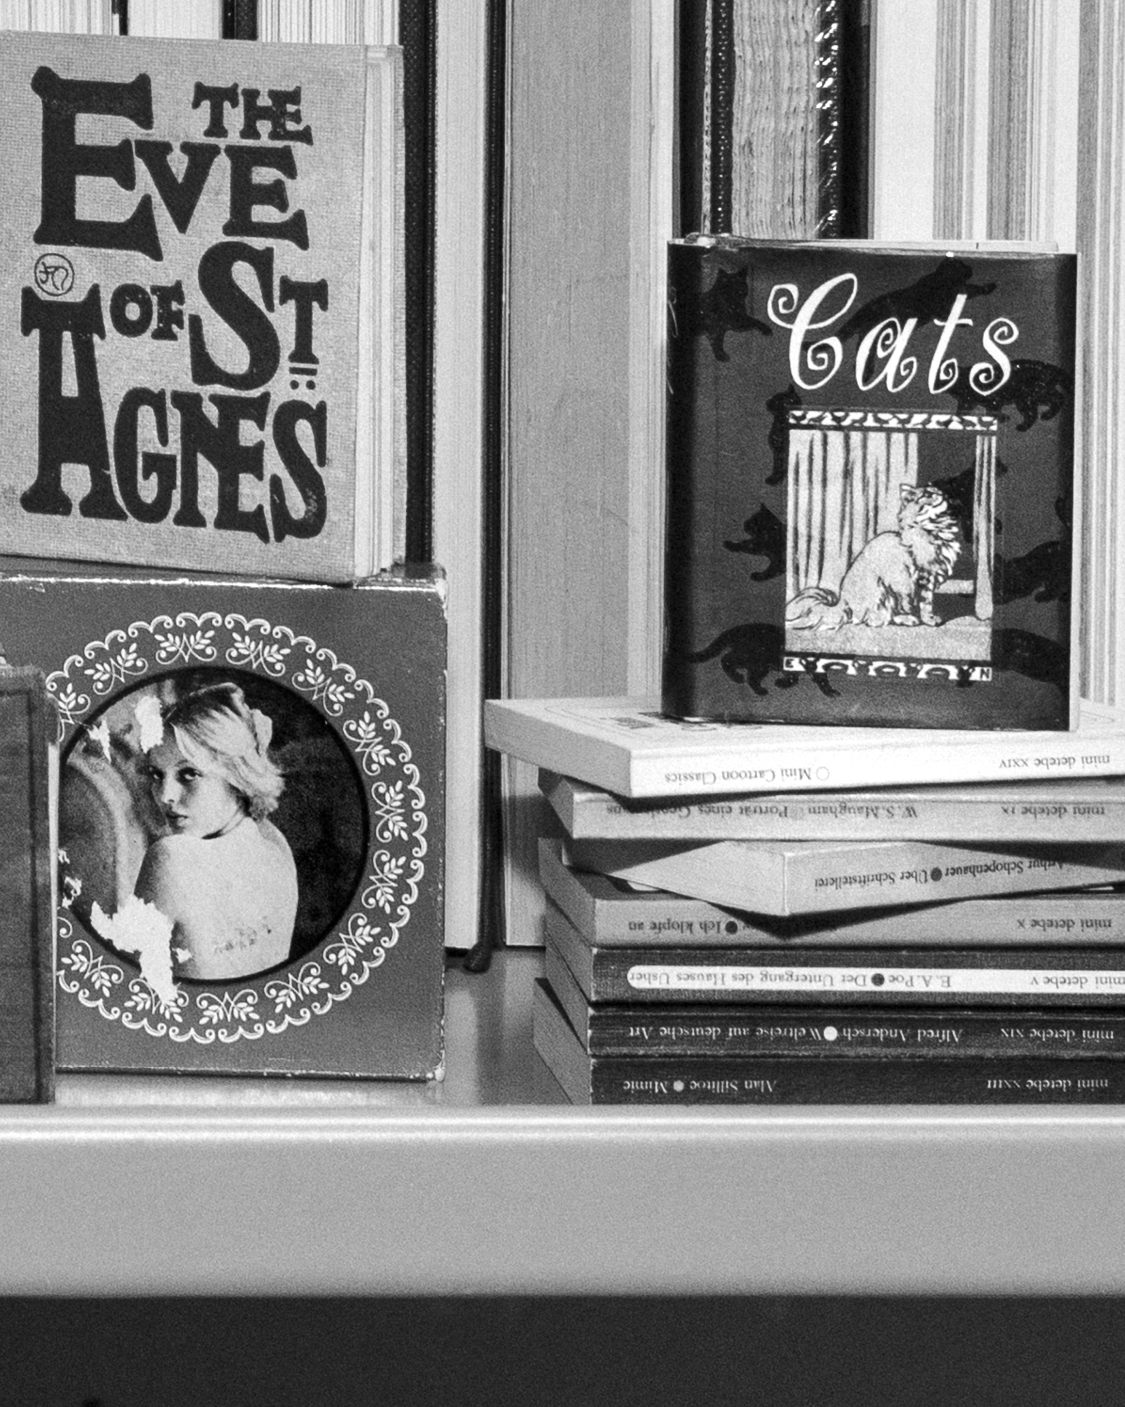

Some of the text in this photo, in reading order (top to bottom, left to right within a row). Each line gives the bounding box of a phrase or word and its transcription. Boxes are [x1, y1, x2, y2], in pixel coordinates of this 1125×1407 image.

[192, 81, 313, 145] THE
[30, 66, 309, 261] EVE
[110, 280, 185, 341] OF
[767, 273, 1019, 396] Cats
[20, 282, 327, 544] AGNES
[1034, 757, 1076, 770] detebe
[1081, 755, 1110, 769] mini
[664, 771, 716, 785] Classics
[721, 769, 776, 783] Cartoon
[780, 768, 812, 781] Mini
[698, 804, 733, 816] eines
[1021, 806, 1068, 820] detebe
[1073, 806, 1105, 819] mini
[945, 860, 1024, 878] Schopenhauer
[815, 871, 895, 891] Schriftstellerei
[628, 920, 645, 930] an
[650, 918, 693, 934] klopfe
[699, 920, 721, 934] Ich
[1031, 919, 1076, 932] detebe
[1081, 919, 1112, 932] mini
[630, 972, 670, 985] Usher
[676, 972, 725, 985] Hauses
[732, 972, 753, 984] des
[760, 971, 833, 986] Untergang
[841, 974, 867, 986] Der
[1043, 975, 1088, 988] detebe
[629, 1026, 653, 1040] Art
[659, 1026, 721, 1040] deutsche
[728, 1026, 750, 1040] auf
[755, 1026, 822, 1041] Weltreise
[842, 1028, 909, 1042] Andersch
[917, 1028, 963, 1043] Alfred
[1029, 1029, 1075, 1042] detebe
[1082, 1029, 1115, 1043] mini
[623, 1080, 668, 1093] Mimic
[689, 1080, 738, 1093] Sillitoe
[744, 1080, 777, 1092] Alan
[1026, 1079, 1072, 1092] detebe
[1077, 1079, 1109, 1092] mini
